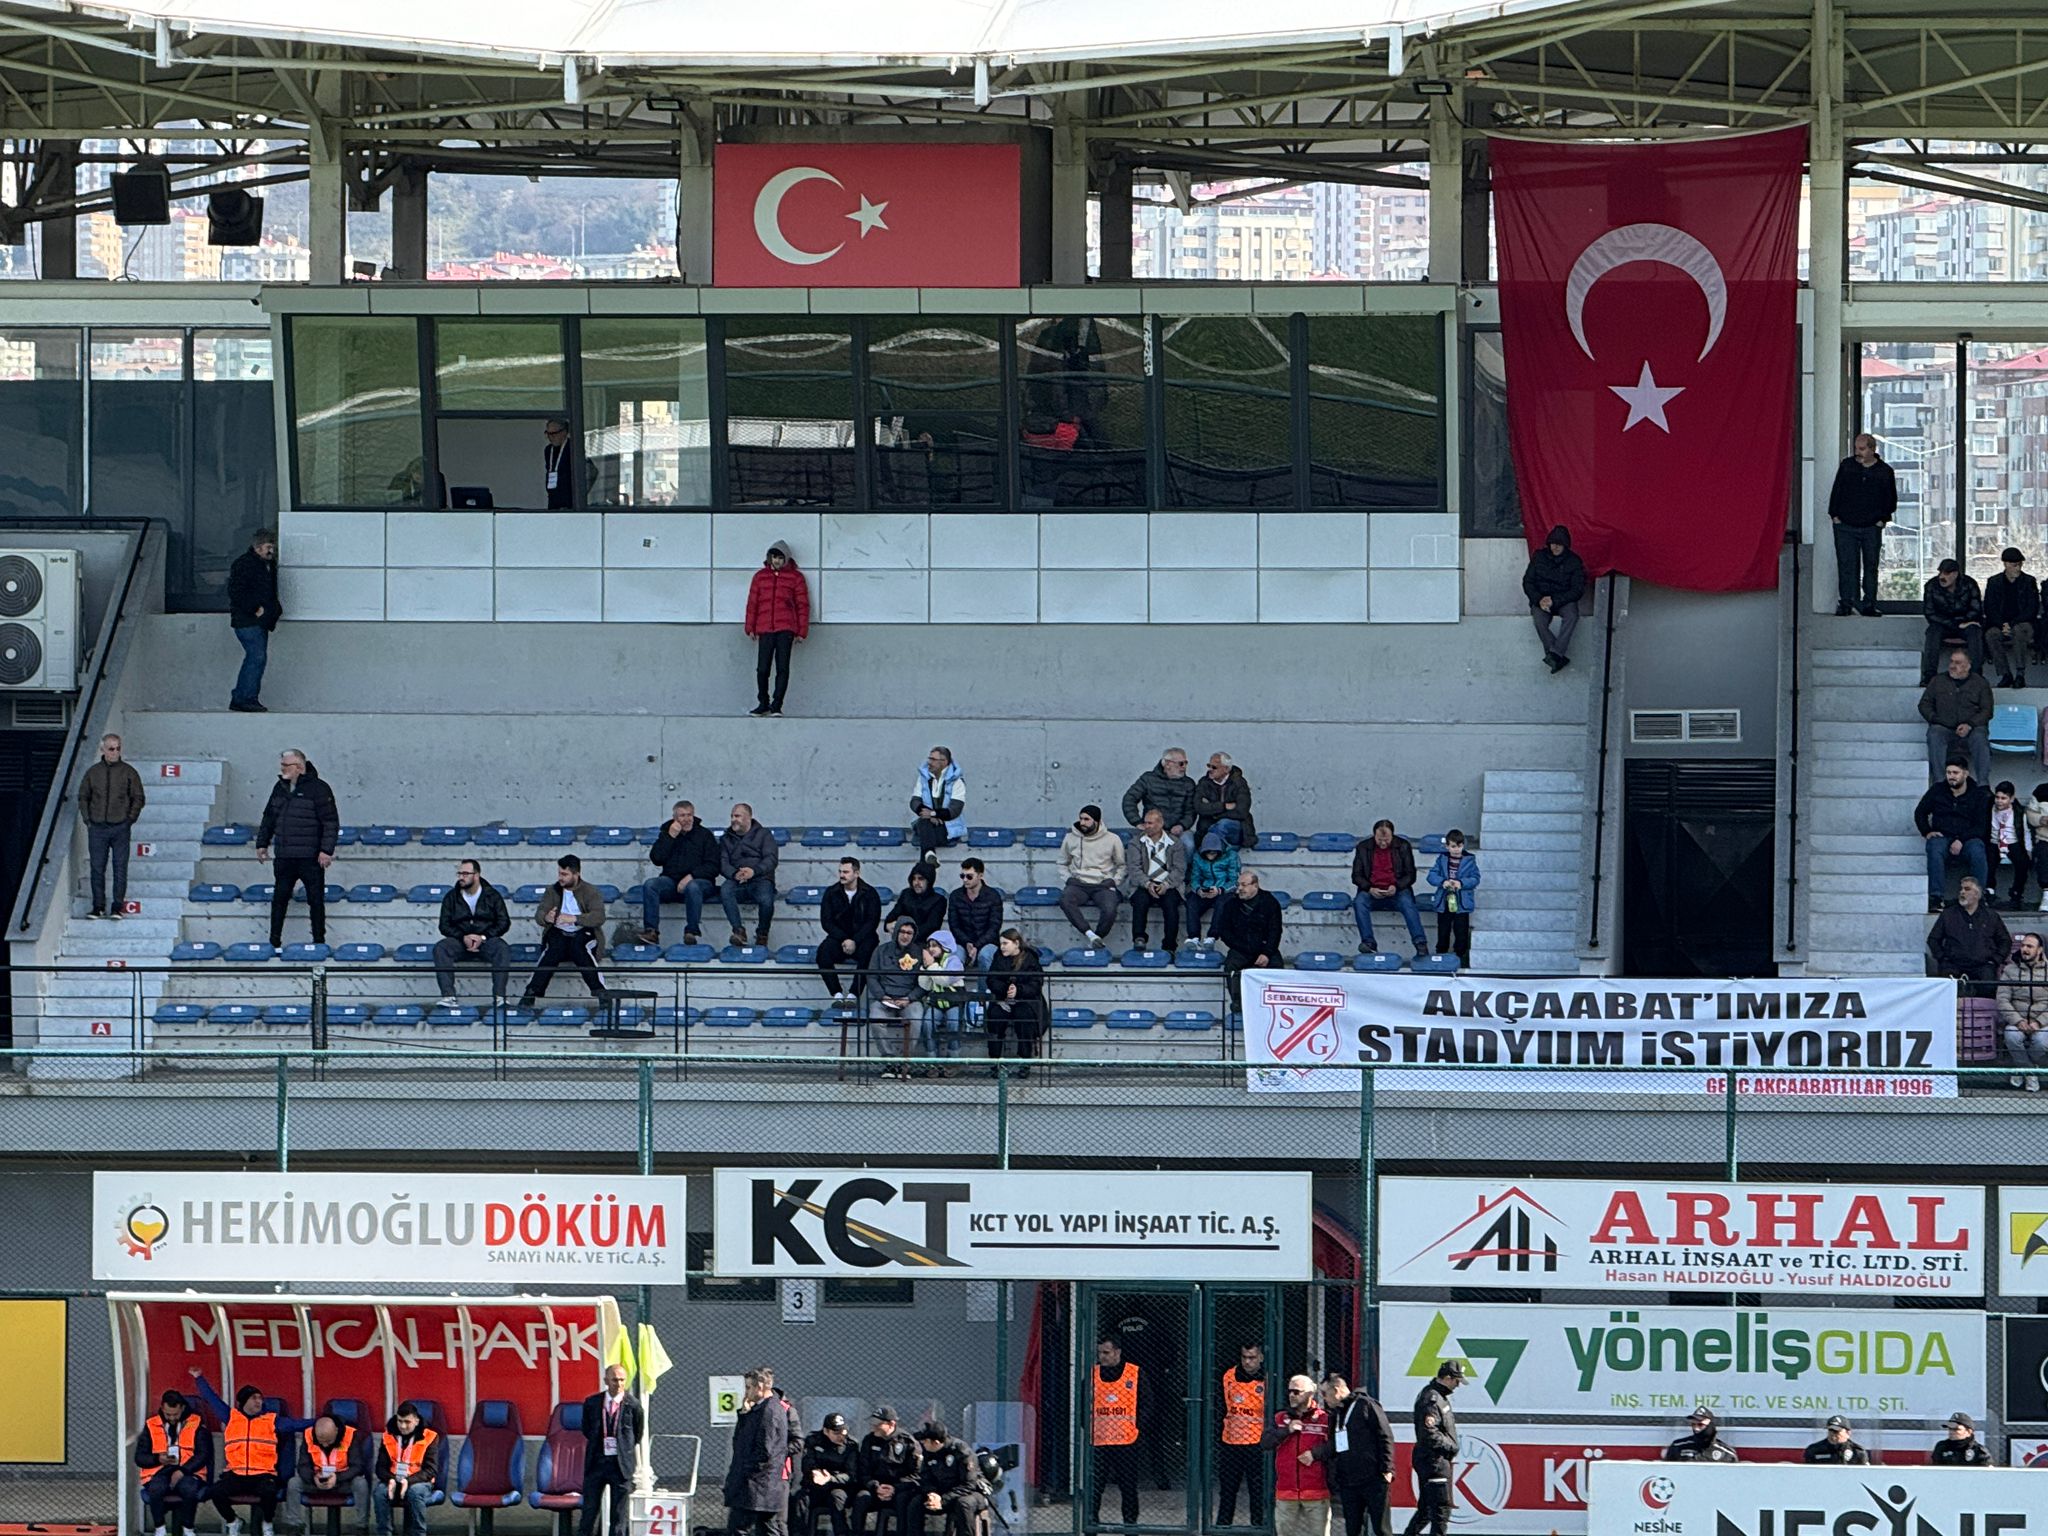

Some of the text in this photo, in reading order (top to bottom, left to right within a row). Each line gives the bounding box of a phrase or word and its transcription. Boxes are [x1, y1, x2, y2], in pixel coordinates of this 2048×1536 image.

[166, 766, 176, 776] E
[143, 845, 151, 856] D
[126, 903, 136, 913] C
[1280, 1008, 1295, 1029] S
[96, 1024, 107, 1035] A
[1307, 1033, 1328, 1055] G
[1358, 1024, 1624, 1064] STADYUM
[1706, 1078, 1750, 1093] GEC
[1890, 1079, 1933, 1095] 1996
[484, 1193, 666, 1247] DÖKÜM
[752, 1178, 971, 1267] KCT
[970, 1210, 1280, 1241] KCT YOL YAPI İNŞAAT TİC. A.Ş.
[1589, 1190, 1969, 1250] ARHAL
[545, 1251, 581, 1263] NAK.
[585, 1252, 604, 1263] VE
[1589, 1250, 1675, 1266] ARHAL
[1779, 1257, 1803, 1268] ve
[1863, 1255, 1916, 1270] LTD.
[1605, 1269, 1657, 1282] Hasan
[1663, 1269, 1774, 1285] HALDIZOĞLU
[1840, 1272, 1951, 1288] HALDIZOĞLU
[793, 1292, 804, 1309] 3
[721, 1394, 734, 1411] 3
[1765, 1396, 1787, 1409] VE
[649, 1505, 678, 1536] 21
